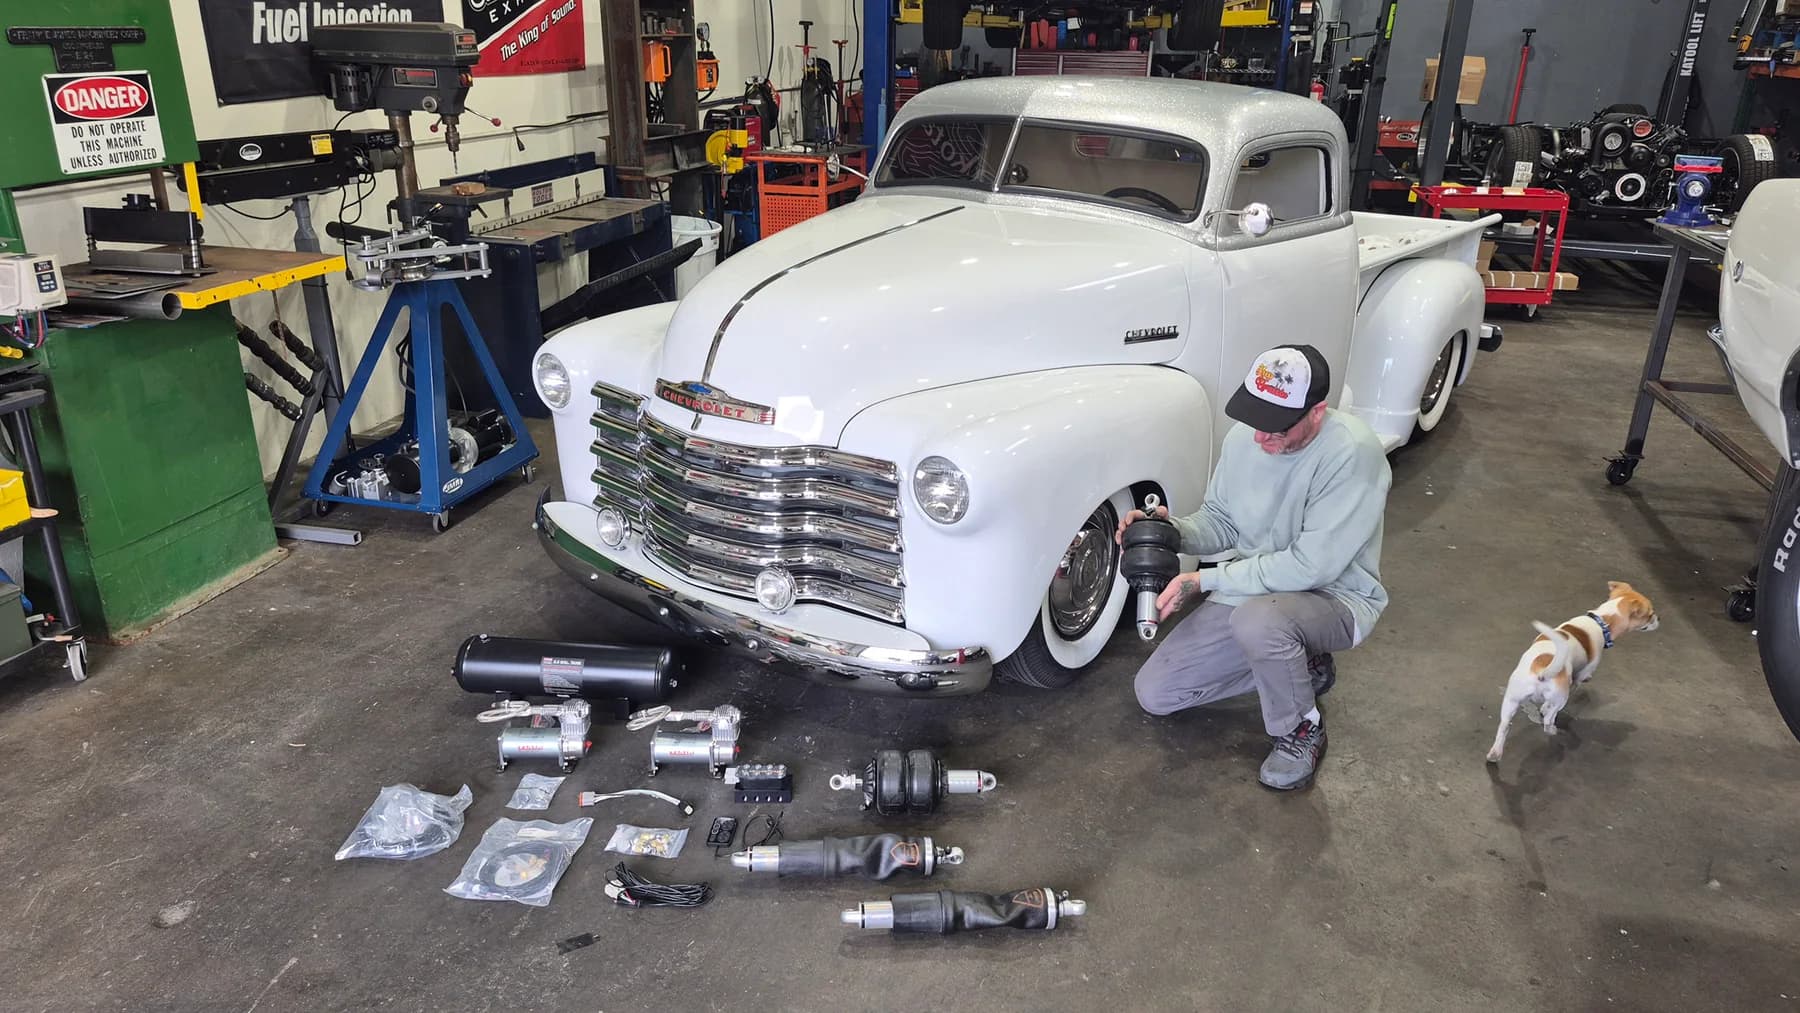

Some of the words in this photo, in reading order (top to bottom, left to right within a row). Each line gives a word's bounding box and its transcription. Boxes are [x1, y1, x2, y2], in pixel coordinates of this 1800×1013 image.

[253, 1, 309, 44] Fuel
[500, 41, 518, 61] The
[518, 25, 539, 50] King
[540, 14, 550, 33] of
[1680, 36, 1700, 77] KATOOL
[1690, 11, 1706, 34] LIFT
[63, 86, 143, 112] DANGER
[71, 125, 84, 138] DO
[89, 124, 105, 137] NOT
[110, 120, 147, 135] OPERATE
[80, 140, 101, 153] THIS
[106, 135, 144, 150] MACHINE
[70, 154, 104, 169] UNLESS
[109, 147, 157, 165] AUTHORIZED
[1125, 325, 1177, 338] CHEVROLET
[663, 390, 745, 418] CHEVROLET
